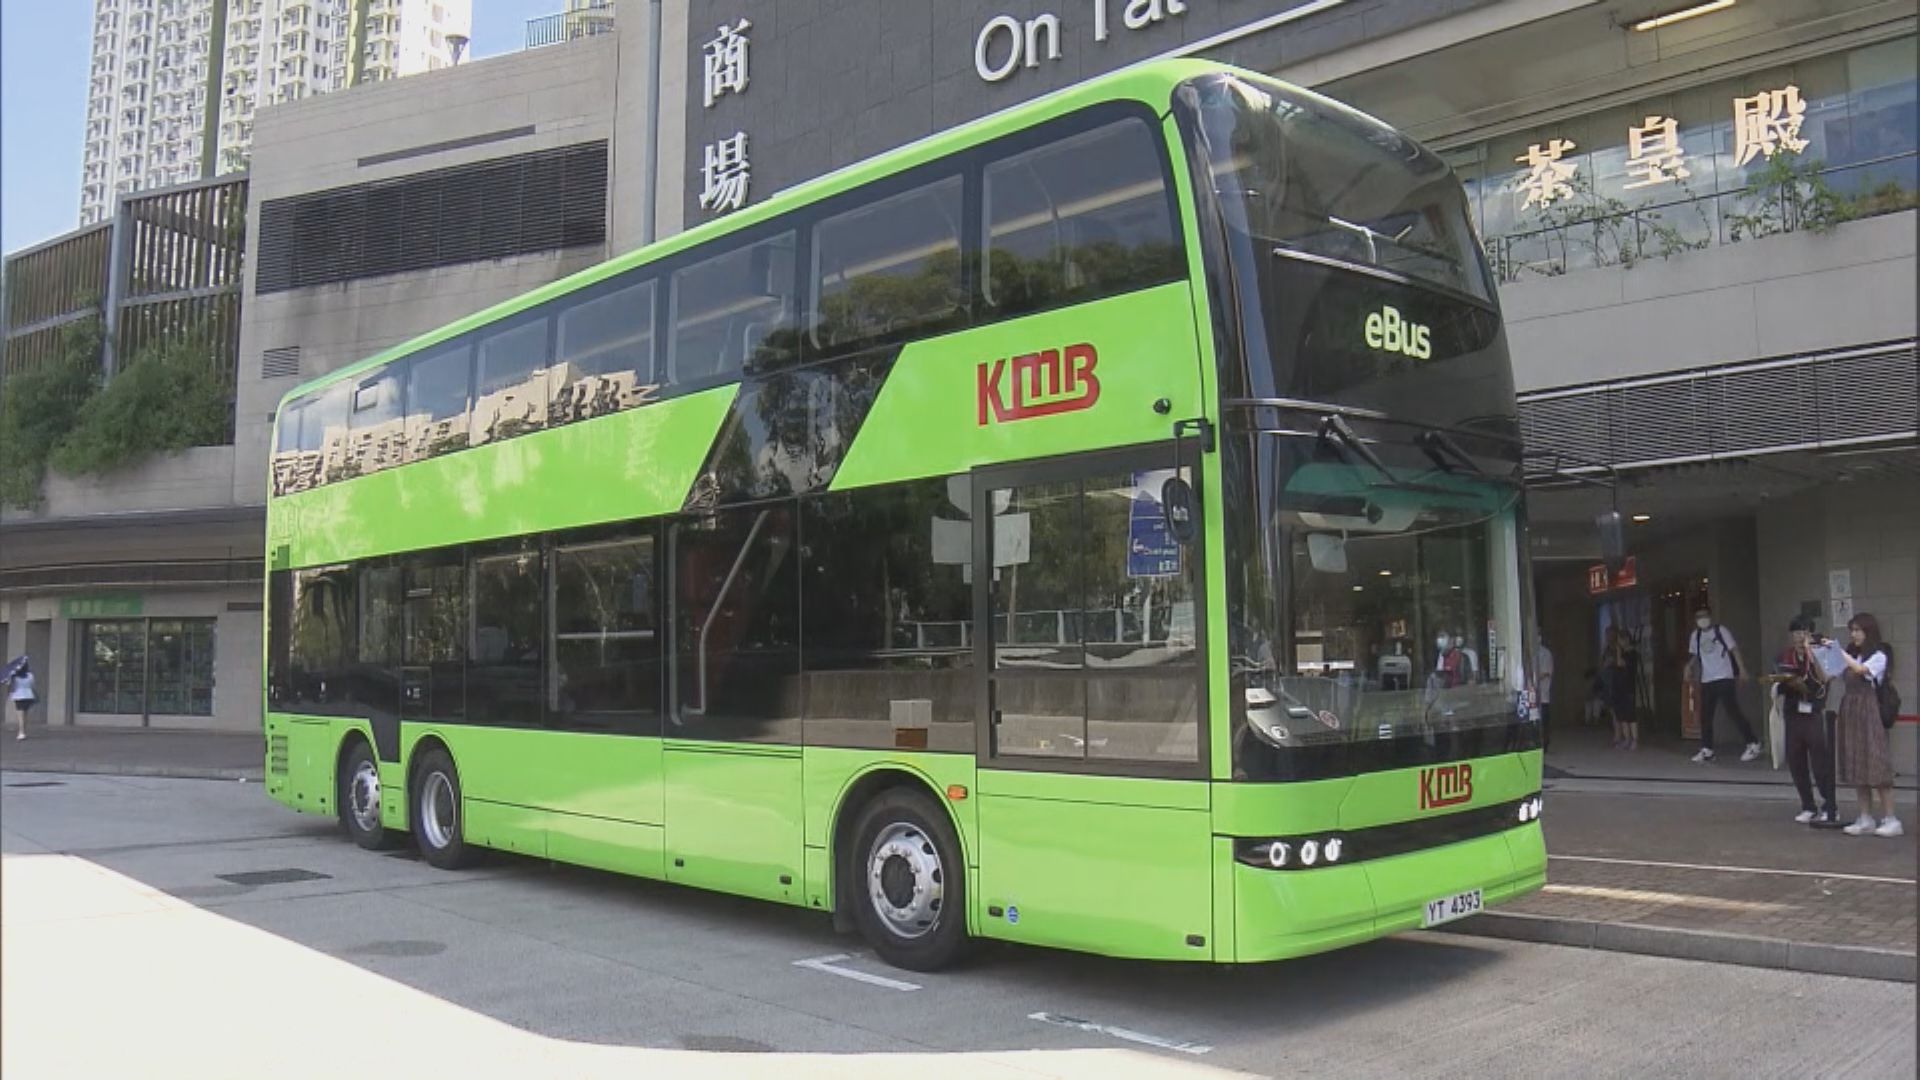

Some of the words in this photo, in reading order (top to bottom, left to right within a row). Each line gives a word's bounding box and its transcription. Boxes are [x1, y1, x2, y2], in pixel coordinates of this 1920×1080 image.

[975, 13, 1062, 82] On
[699, 17, 751, 213] 商場
[1514, 85, 1810, 211] 茶皇殿
[1364, 304, 1432, 360] eBus
[976, 342, 1100, 427] KMB
[1418, 763, 1473, 810] KMB
[1428, 900, 1446, 922] YT
[1450, 890, 1481, 914] 4393
